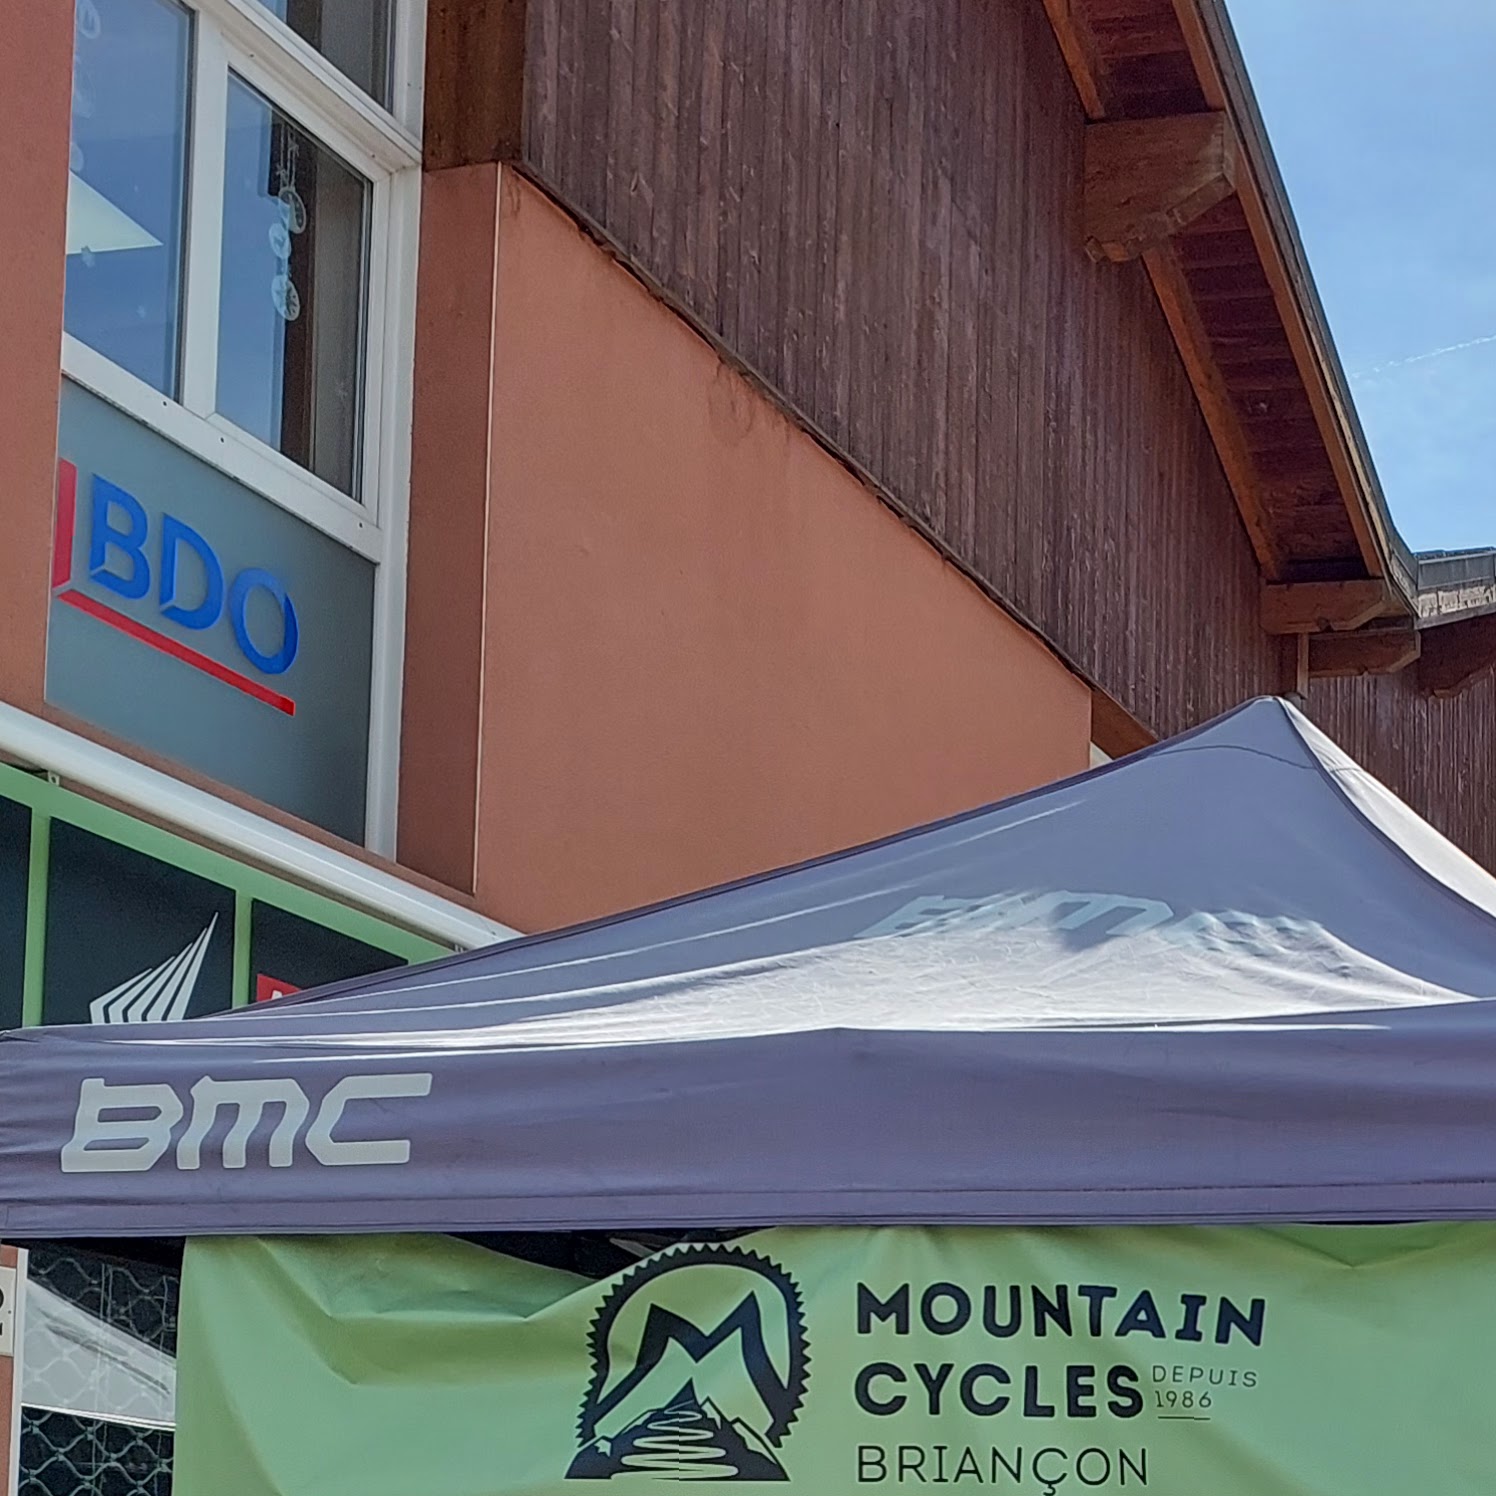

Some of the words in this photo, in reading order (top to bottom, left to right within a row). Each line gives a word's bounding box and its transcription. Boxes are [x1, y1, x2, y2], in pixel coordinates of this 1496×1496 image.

[89, 472, 299, 675] BDO
[60, 1072, 433, 1173] BMC
[856, 1281, 1266, 1347] MOUNTAIN
[854, 1361, 1144, 1419] CYCLES
[1151, 1364, 1258, 1388] DEPUIS
[1154, 1389, 1213, 1409] 1986
[857, 1445, 1148, 1496] BRIANÇON
